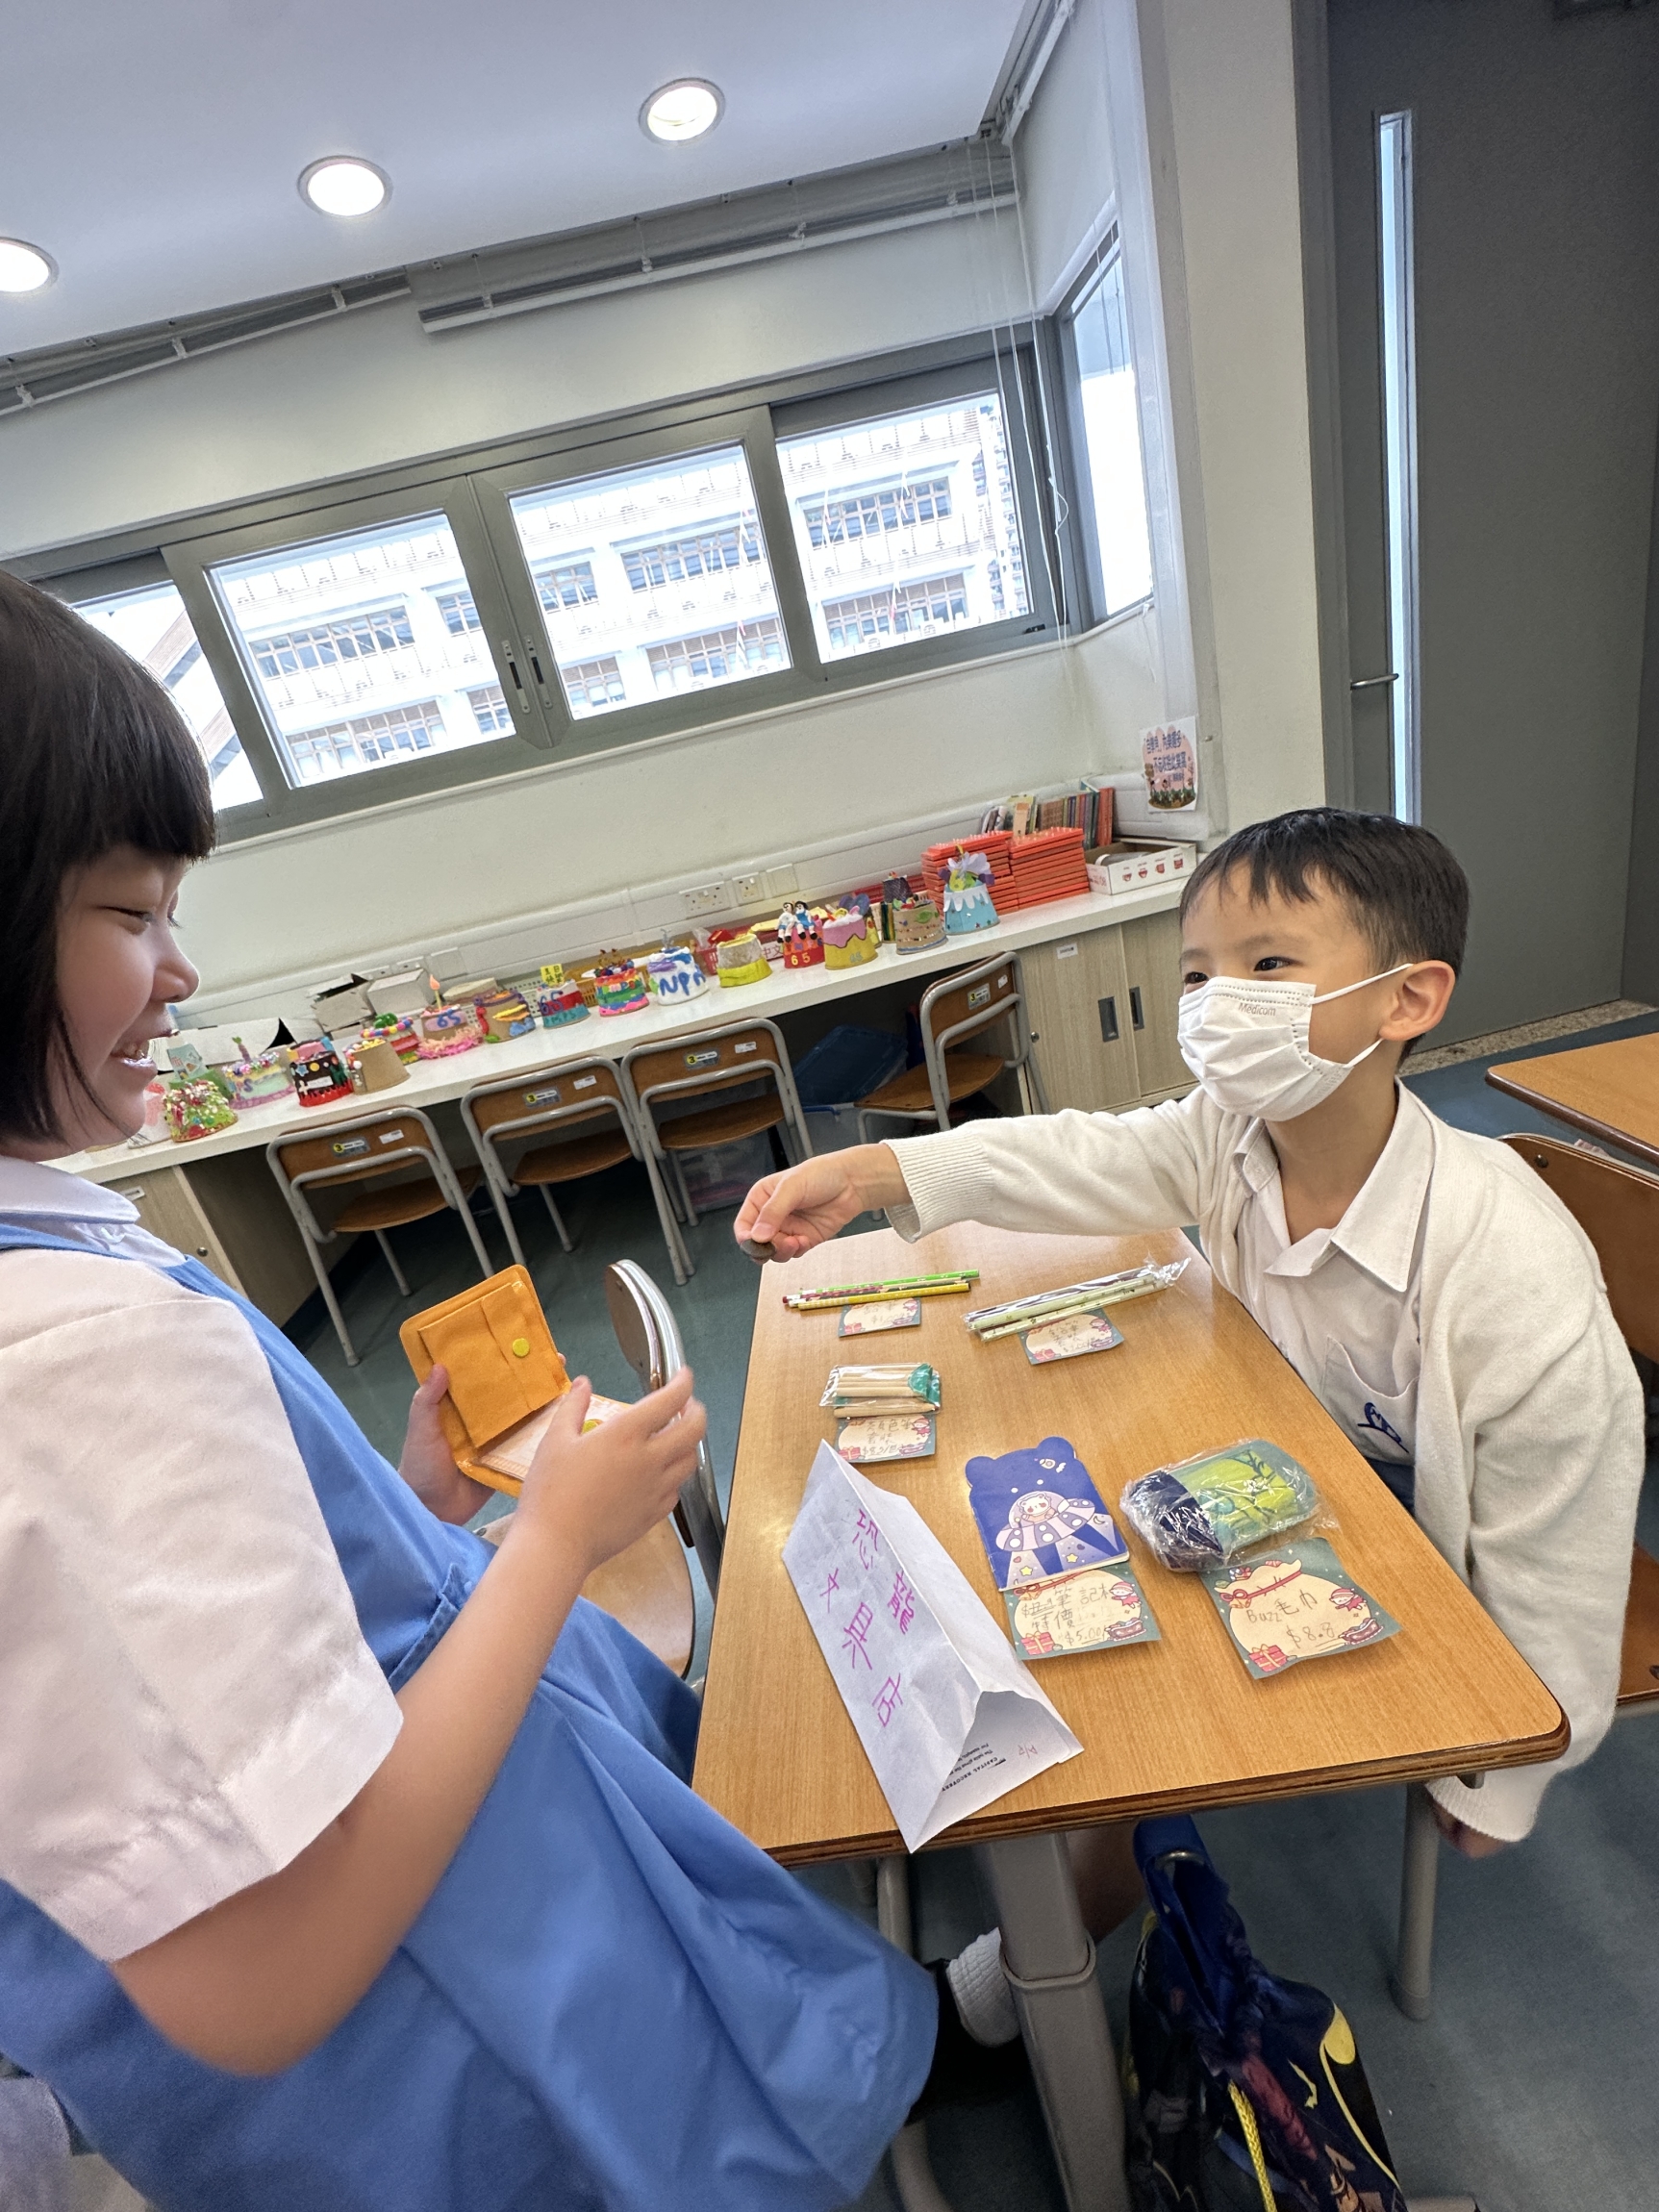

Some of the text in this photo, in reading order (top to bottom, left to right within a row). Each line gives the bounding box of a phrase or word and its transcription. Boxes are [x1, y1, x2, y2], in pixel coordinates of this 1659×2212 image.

[791, 952, 811, 966] 65
[539, 981, 565, 1015] 65
[1238, 1002, 1276, 1016] Medicom
[437, 1009, 461, 1028] 65
[852, 1509, 916, 1635] 恐龍
[1054, 1582, 1110, 1608] 筆記本
[1031, 1610, 1075, 1634] 特價
[1286, 1621, 1337, 1648] $8.8
[819, 1568, 903, 1727] 文具店
[972, 1756, 998, 1772] CAPITAL
